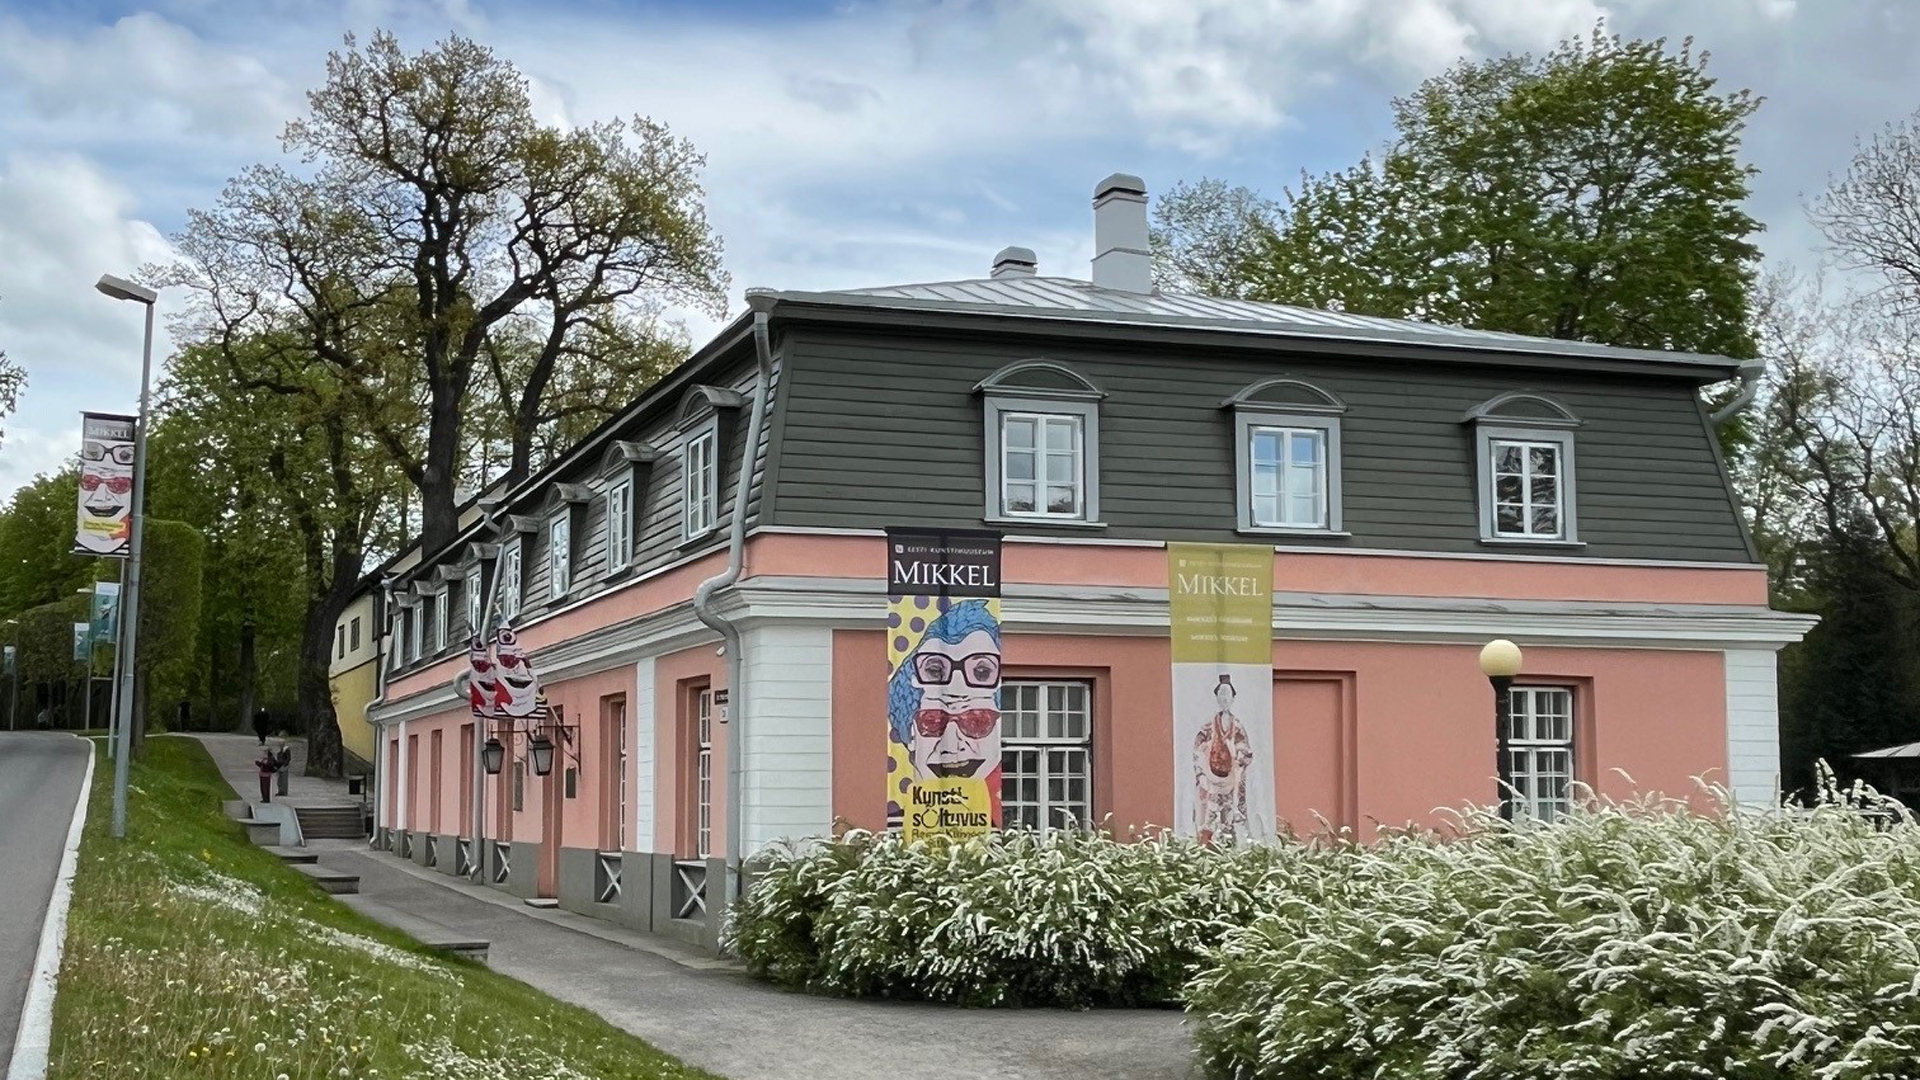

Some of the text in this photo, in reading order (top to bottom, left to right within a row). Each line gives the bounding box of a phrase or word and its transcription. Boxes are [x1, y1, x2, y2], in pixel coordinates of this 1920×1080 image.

[88, 425, 130, 439] MIKKEL
[907, 545, 928, 553] EESTI
[893, 560, 995, 587] MIKKEL
[1178, 573, 1264, 596] MIKKEL
